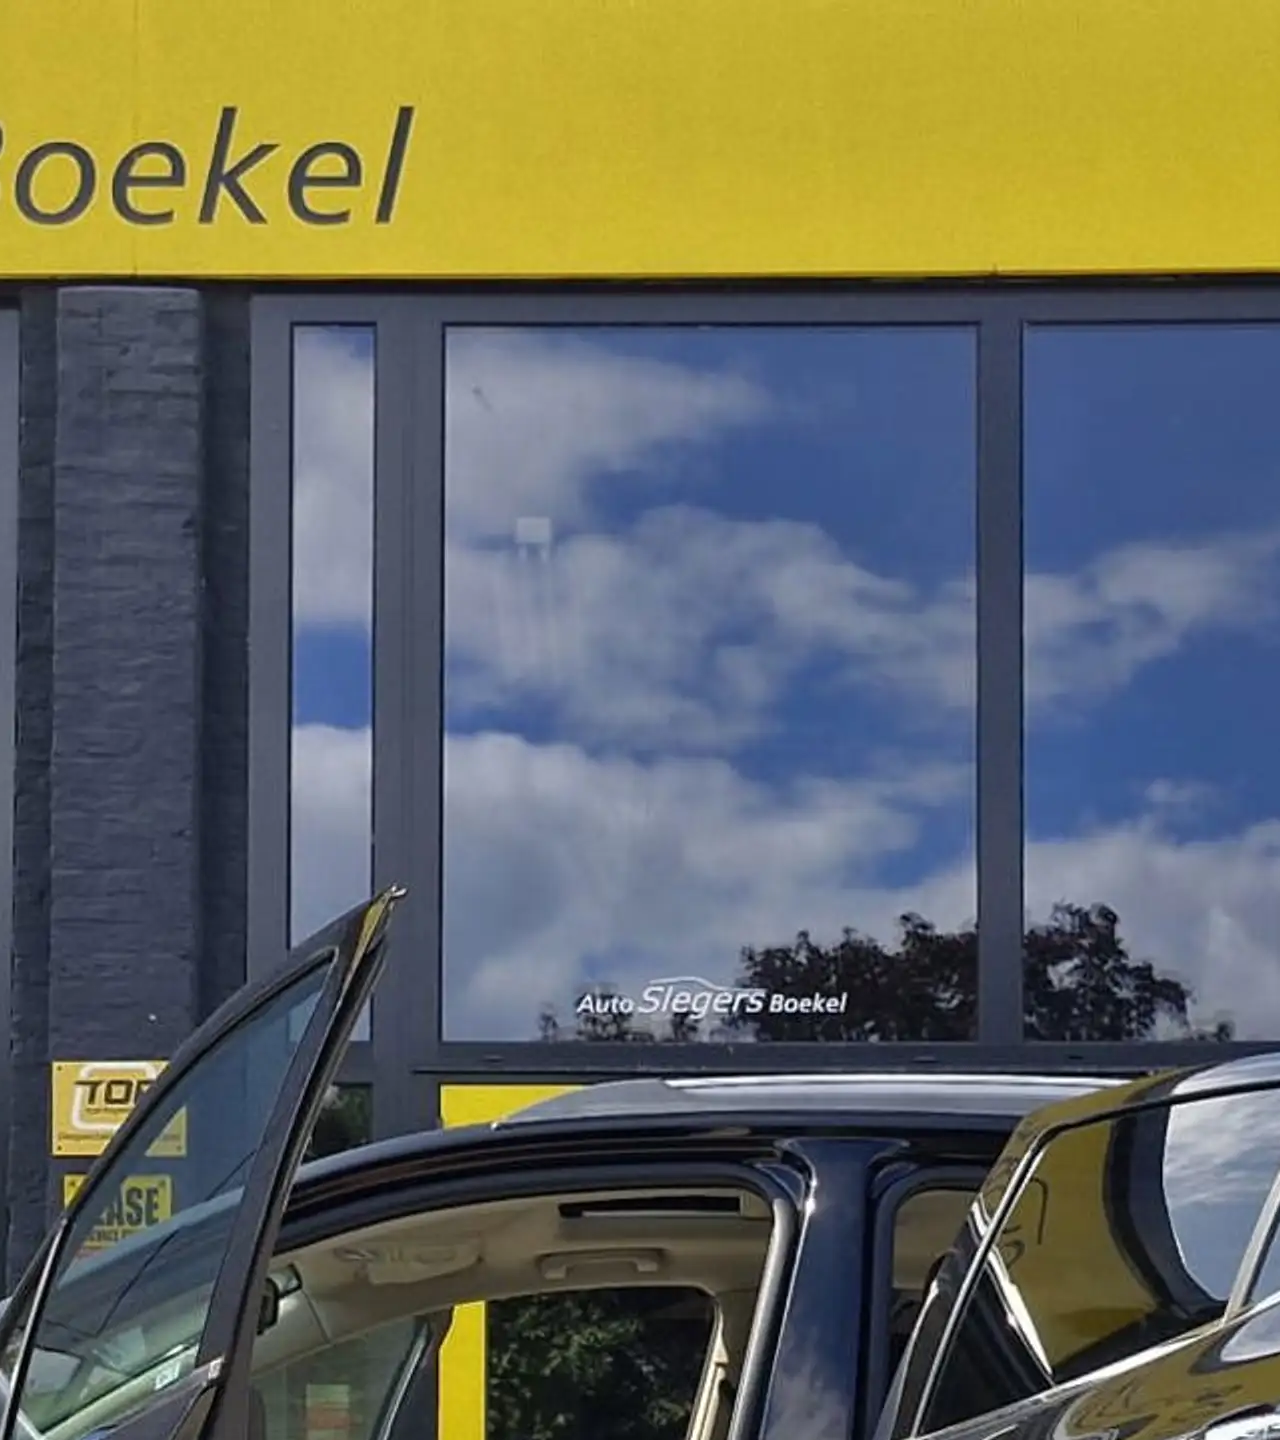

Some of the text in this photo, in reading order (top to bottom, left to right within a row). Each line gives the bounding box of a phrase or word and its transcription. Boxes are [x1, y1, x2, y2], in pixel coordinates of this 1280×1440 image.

[576, 985, 847, 1019] Auto Slegers Boekel
